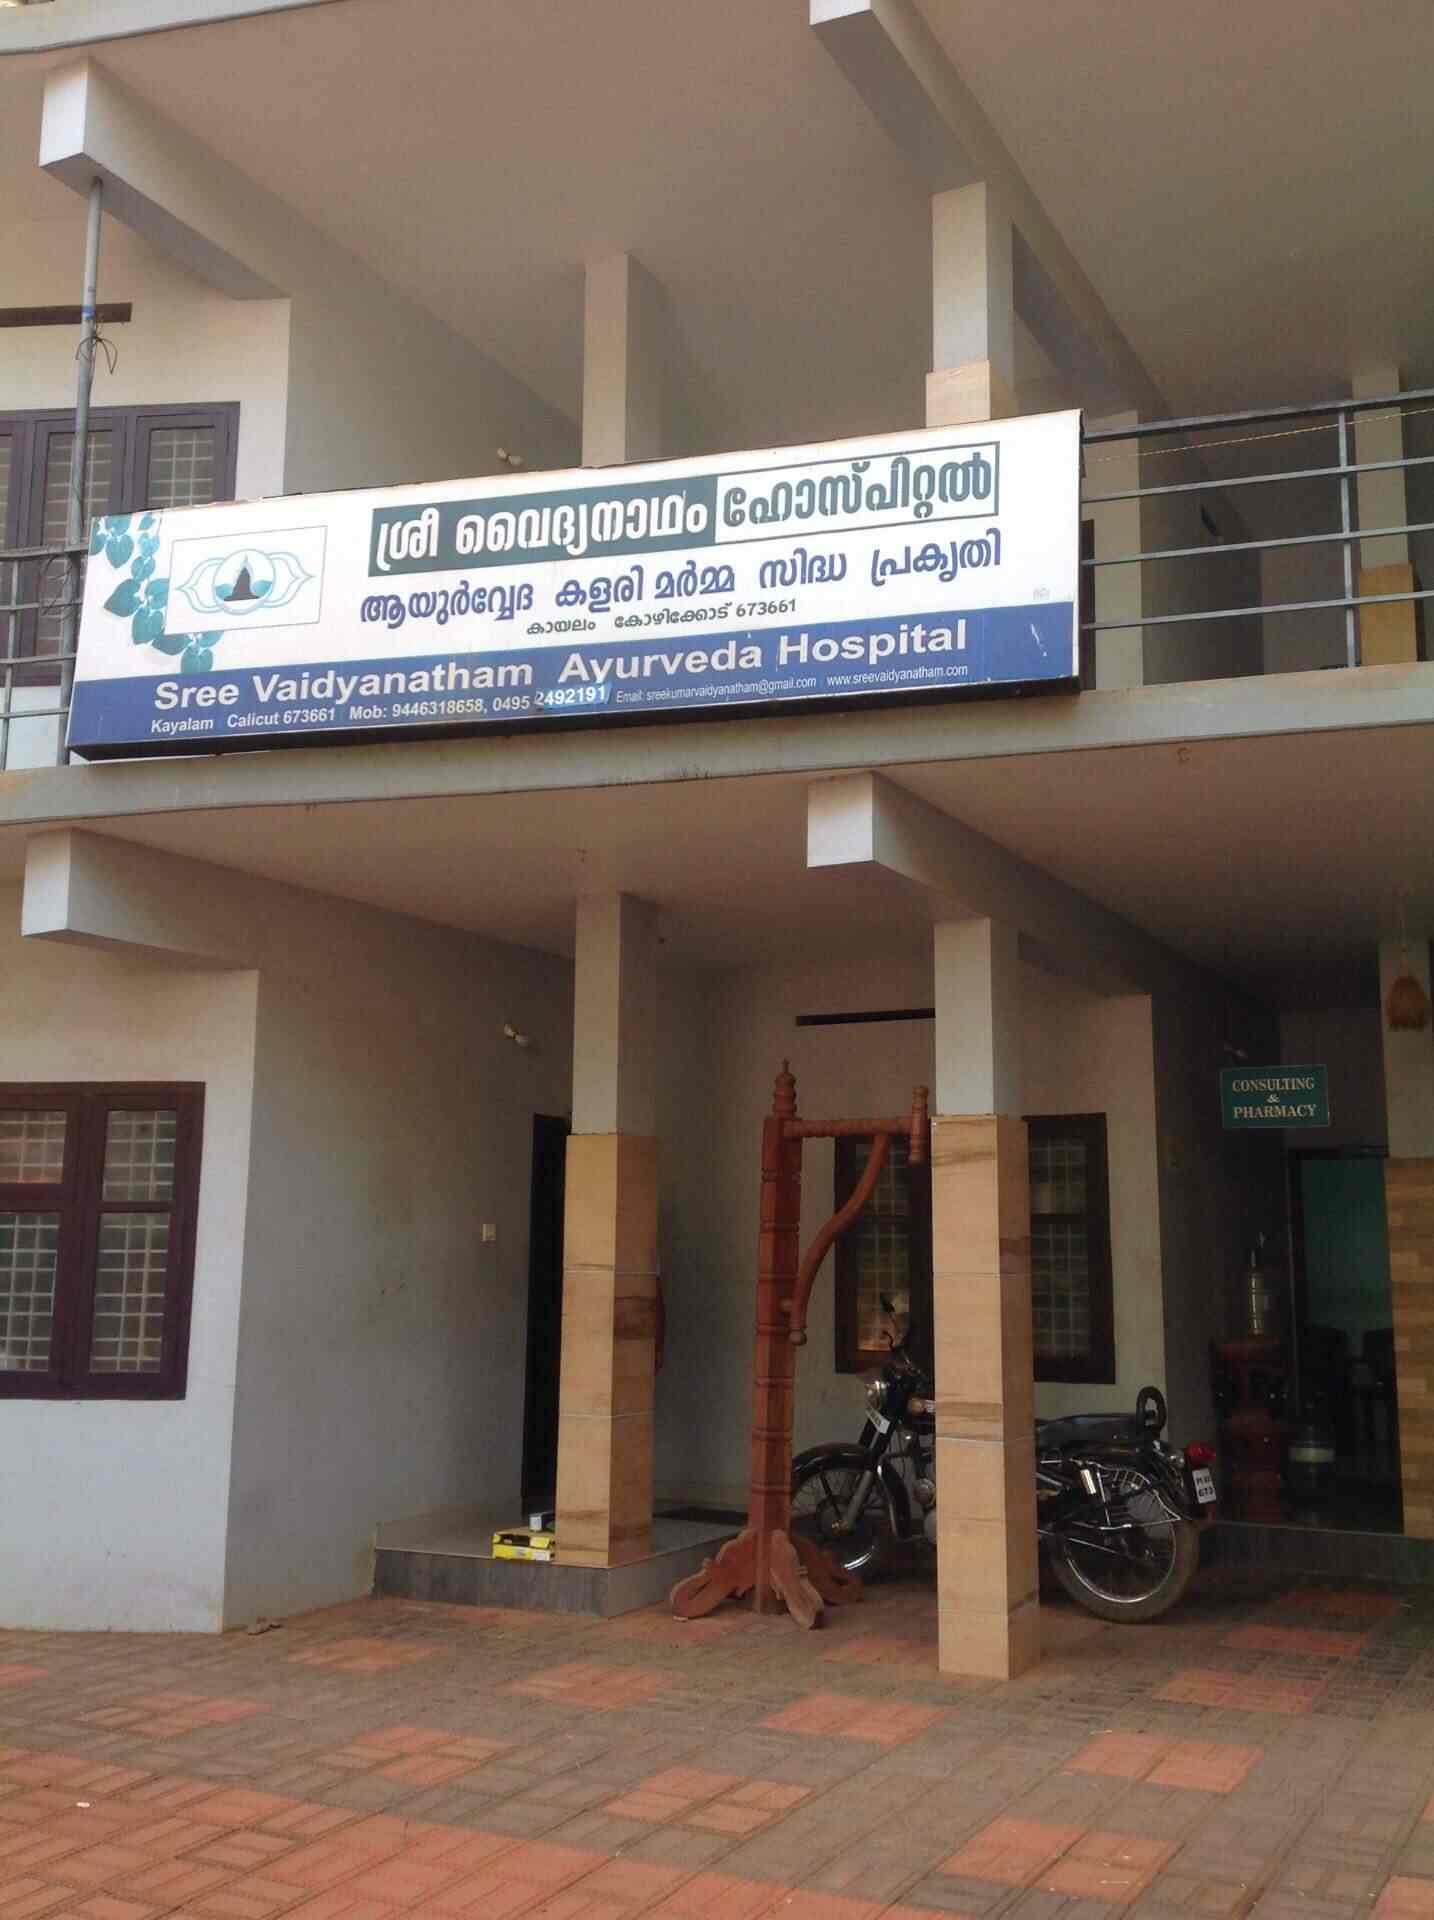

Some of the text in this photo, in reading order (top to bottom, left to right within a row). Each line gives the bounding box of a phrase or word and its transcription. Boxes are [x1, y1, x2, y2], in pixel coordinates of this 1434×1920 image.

[376, 507, 440, 572] ശ്രീ
[554, 565, 644, 613] കളരി
[759, 547, 848, 589] സിദ്ധ
[871, 527, 1001, 587] പ്രകൃതി
[526, 618, 597, 635] കായലം
[736, 599, 797, 618] 673661
[154, 619, 966, 710] Sree Vaidyanatham Ayurveda Hospital
[151, 717, 214, 736] Kayalam
[227, 710, 279, 728] Calicut
[283, 707, 335, 724] 673661
[349, 704, 388, 721] Mob:
[391, 697, 488, 718] 9446318658,
[492, 695, 530, 712] 0495
[826, 664, 969, 687] www.sreevaidyanatham.com
[1232, 1078, 1314, 1092] CONSULTING
[1267, 1093, 1280, 1103] &
[1233, 1104, 1316, 1118] PHARMACY
